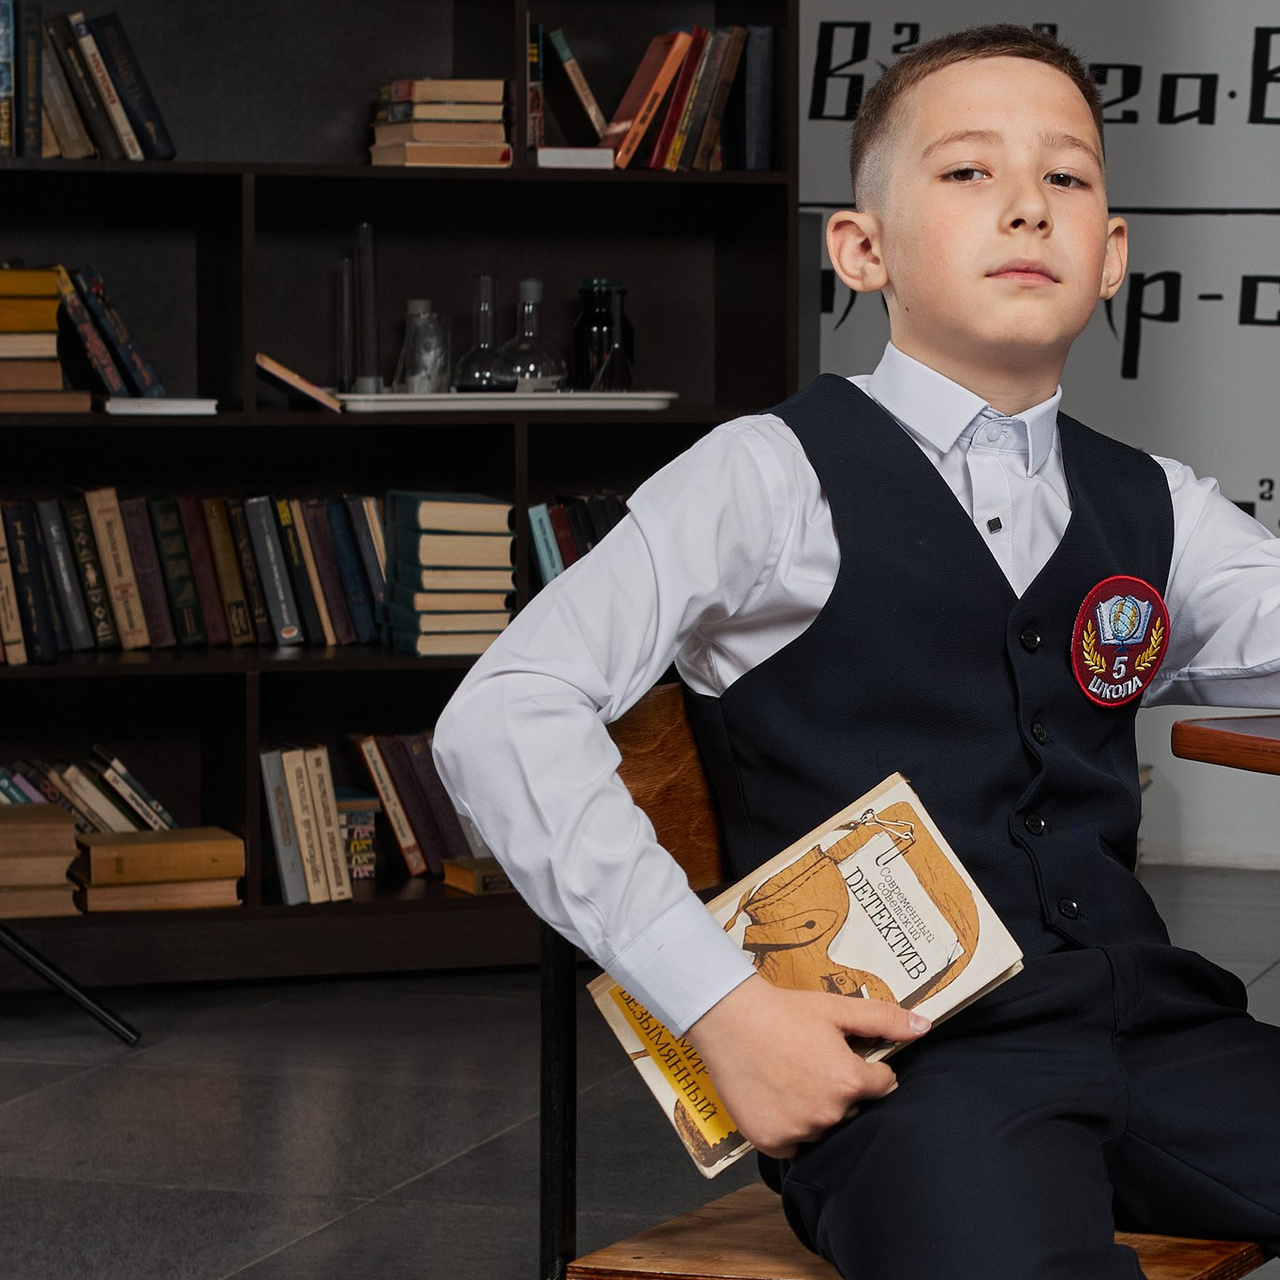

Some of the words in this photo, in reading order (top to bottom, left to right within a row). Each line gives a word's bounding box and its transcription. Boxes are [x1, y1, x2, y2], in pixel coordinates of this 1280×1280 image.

[1088, 675, 1143, 700] ШКОЛА
[1112, 656, 1128, 679] 5
[877, 882, 922, 942] советский
[880, 866, 935, 944] Современный
